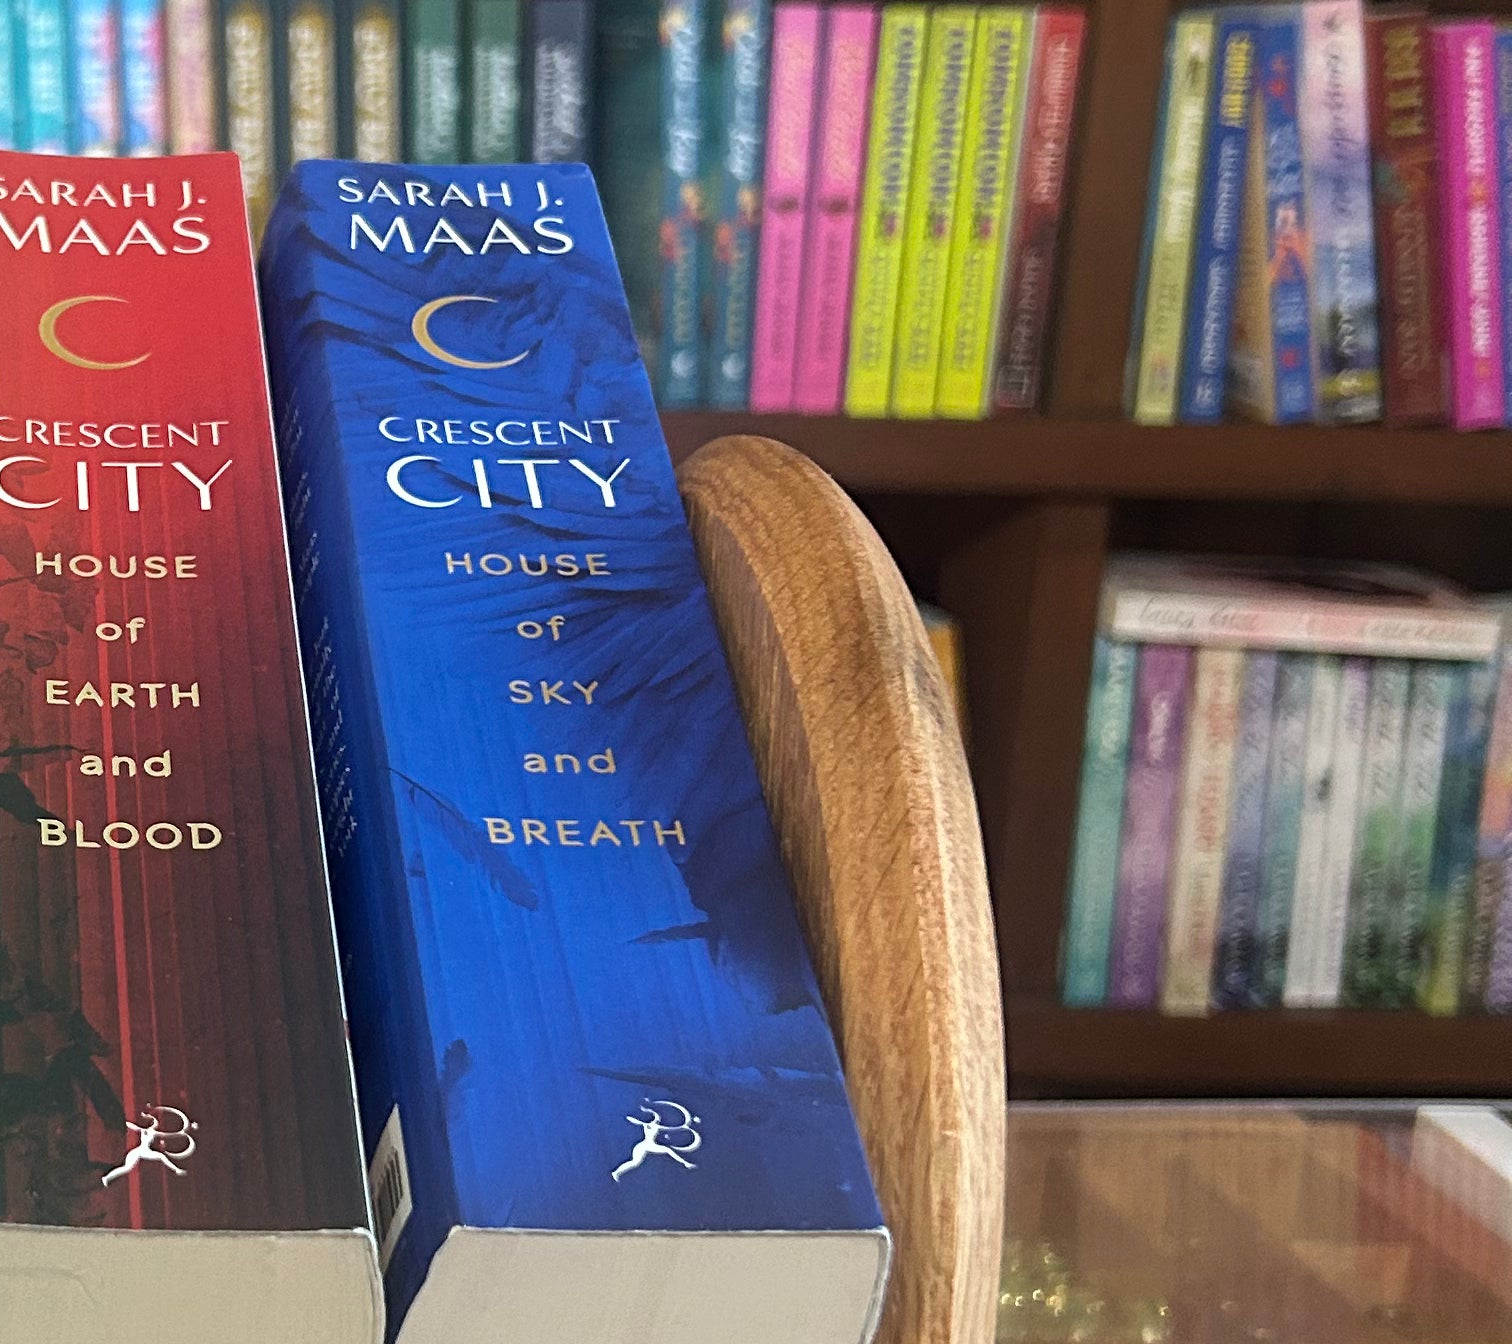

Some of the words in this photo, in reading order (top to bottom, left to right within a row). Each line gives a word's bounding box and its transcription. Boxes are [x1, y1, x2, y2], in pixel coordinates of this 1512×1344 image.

[180, 180, 207, 210] J.
[338, 177, 512, 208] SARAH
[536, 181, 563, 211] J.
[349, 212, 574, 255] MAAS
[378, 416, 620, 446] CRESCENT
[385, 454, 631, 509] CITY
[35, 551, 199, 579] HOUSE
[445, 552, 612, 576] HOUSE
[95, 616, 146, 645] of
[516, 615, 565, 641] of
[45, 679, 201, 709] EARTH
[508, 679, 599, 705] SKY
[79, 749, 172, 778] and
[523, 747, 616, 774] and
[36, 818, 223, 850] BLOOD
[482, 817, 686, 847] BREATH
